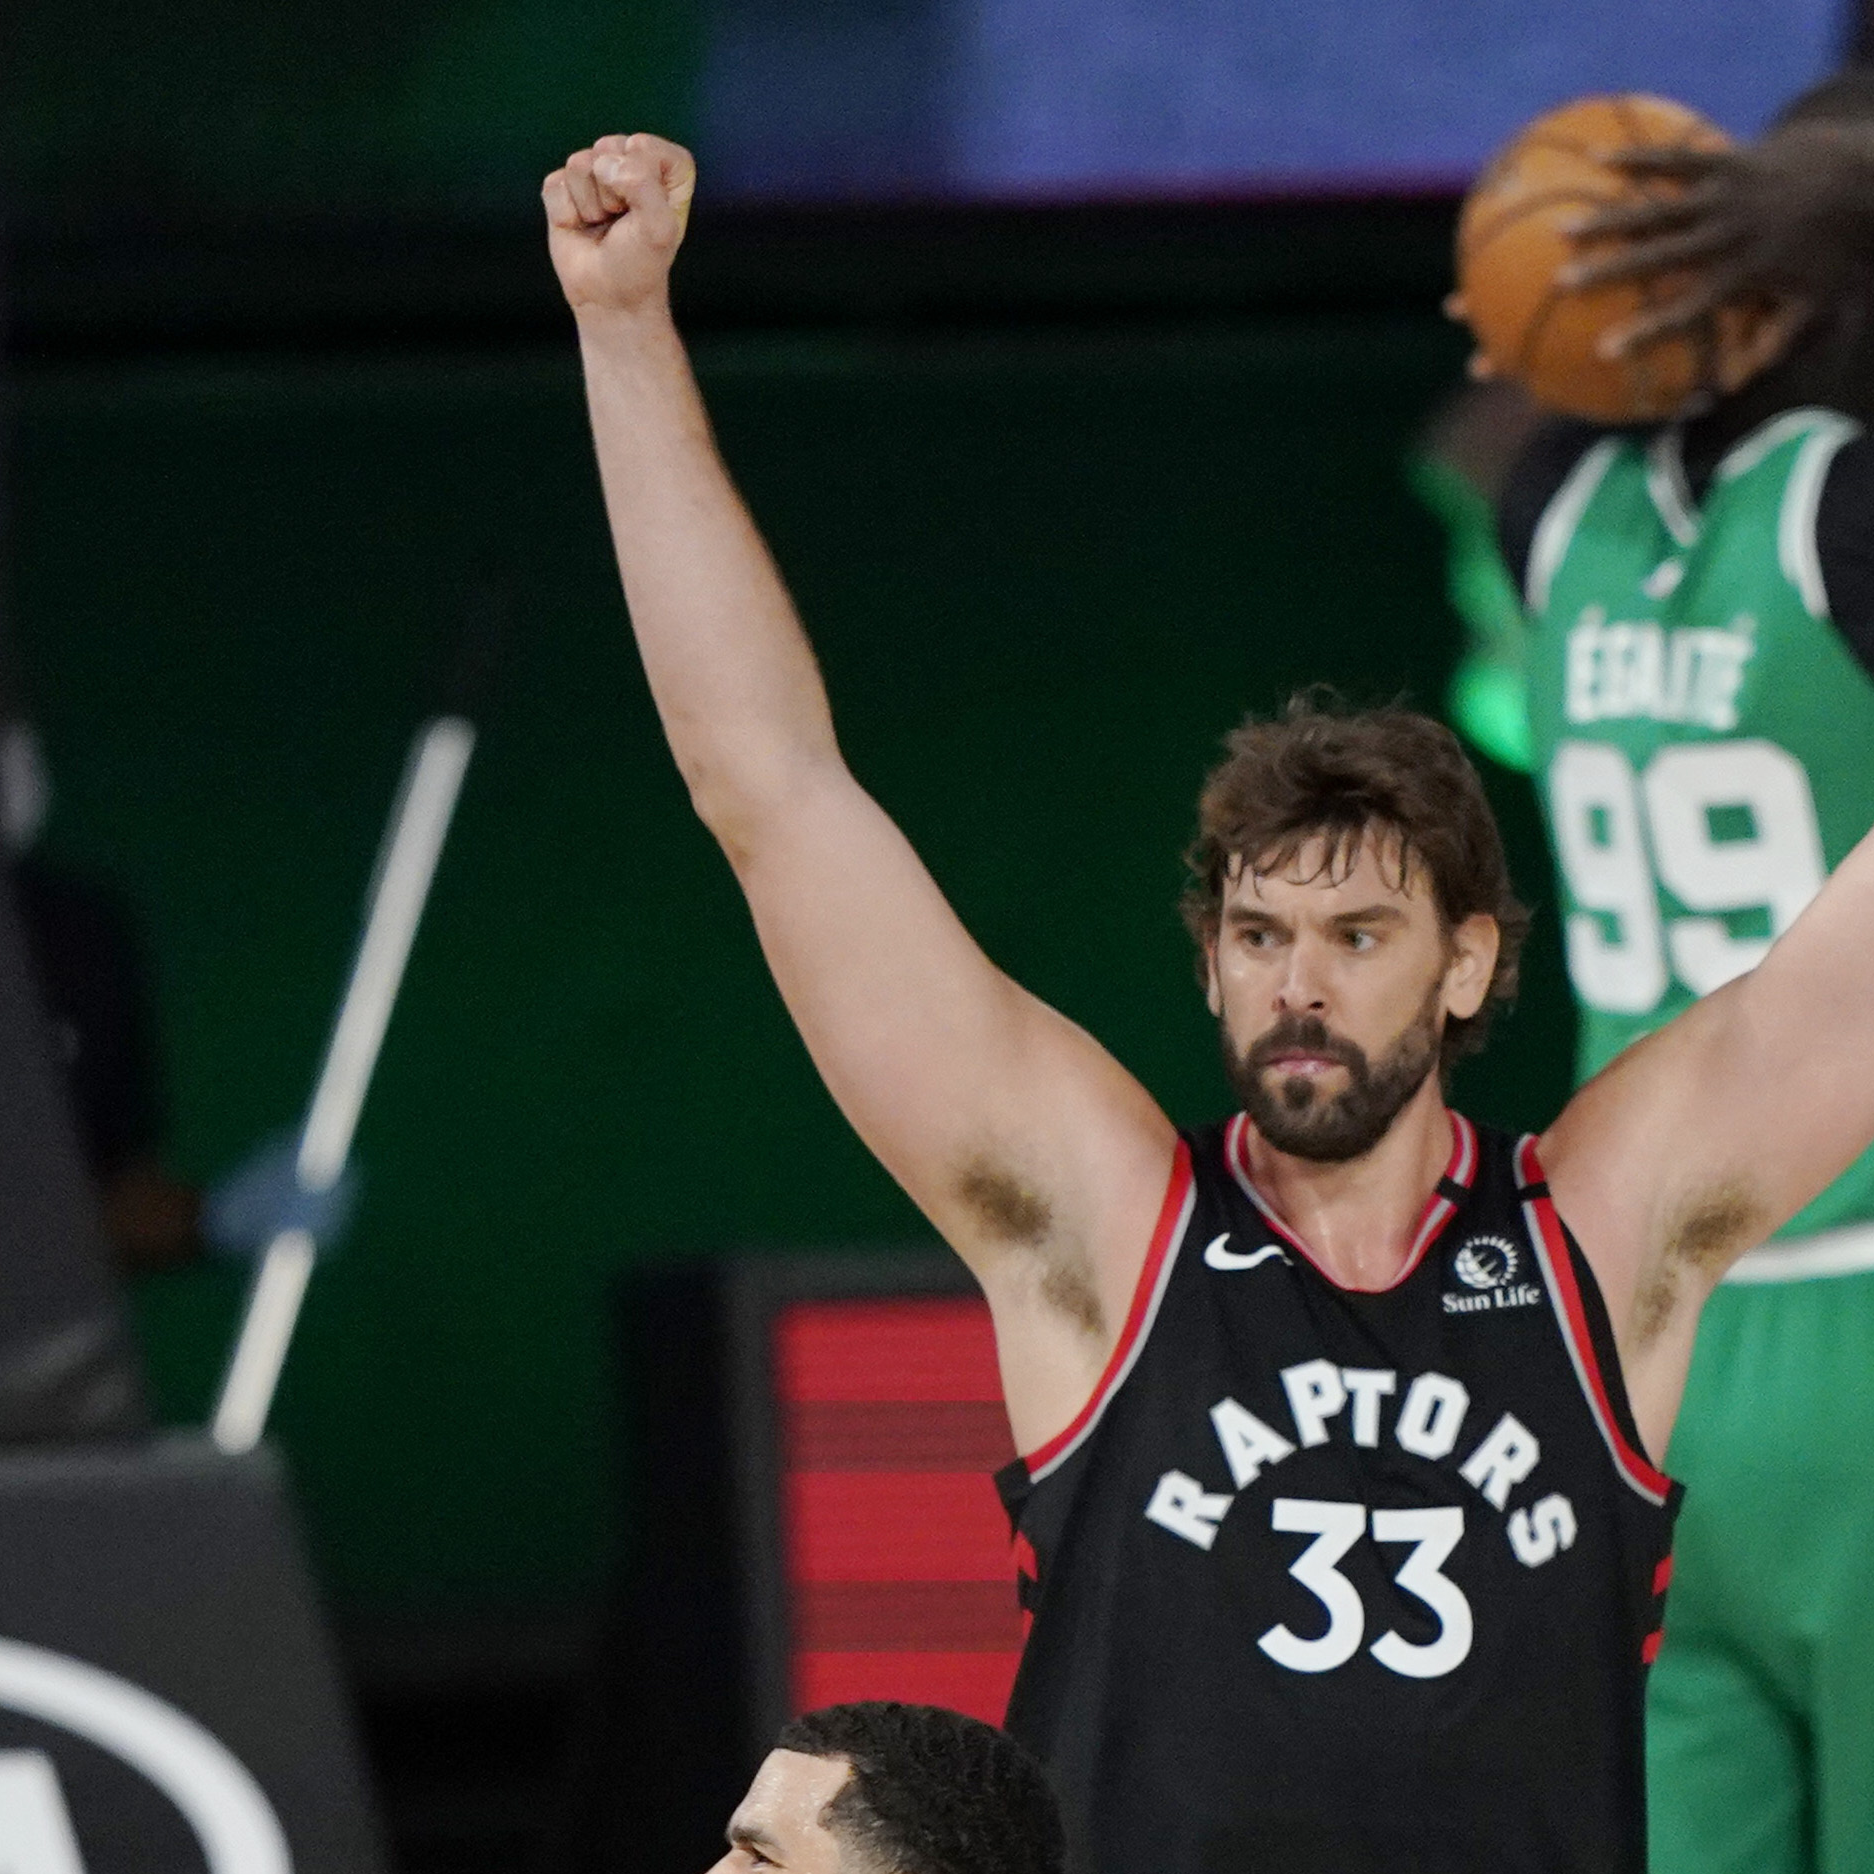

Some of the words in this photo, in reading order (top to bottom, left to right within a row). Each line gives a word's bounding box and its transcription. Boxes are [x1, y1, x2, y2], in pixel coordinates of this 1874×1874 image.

[1549, 740, 1829, 1014] 99
[1442, 1291, 1491, 1313] Sun
[1494, 1283, 1541, 1308] Life
[1144, 1358, 1578, 1568] RAPTORS
[1256, 1497, 1474, 1678] 33
